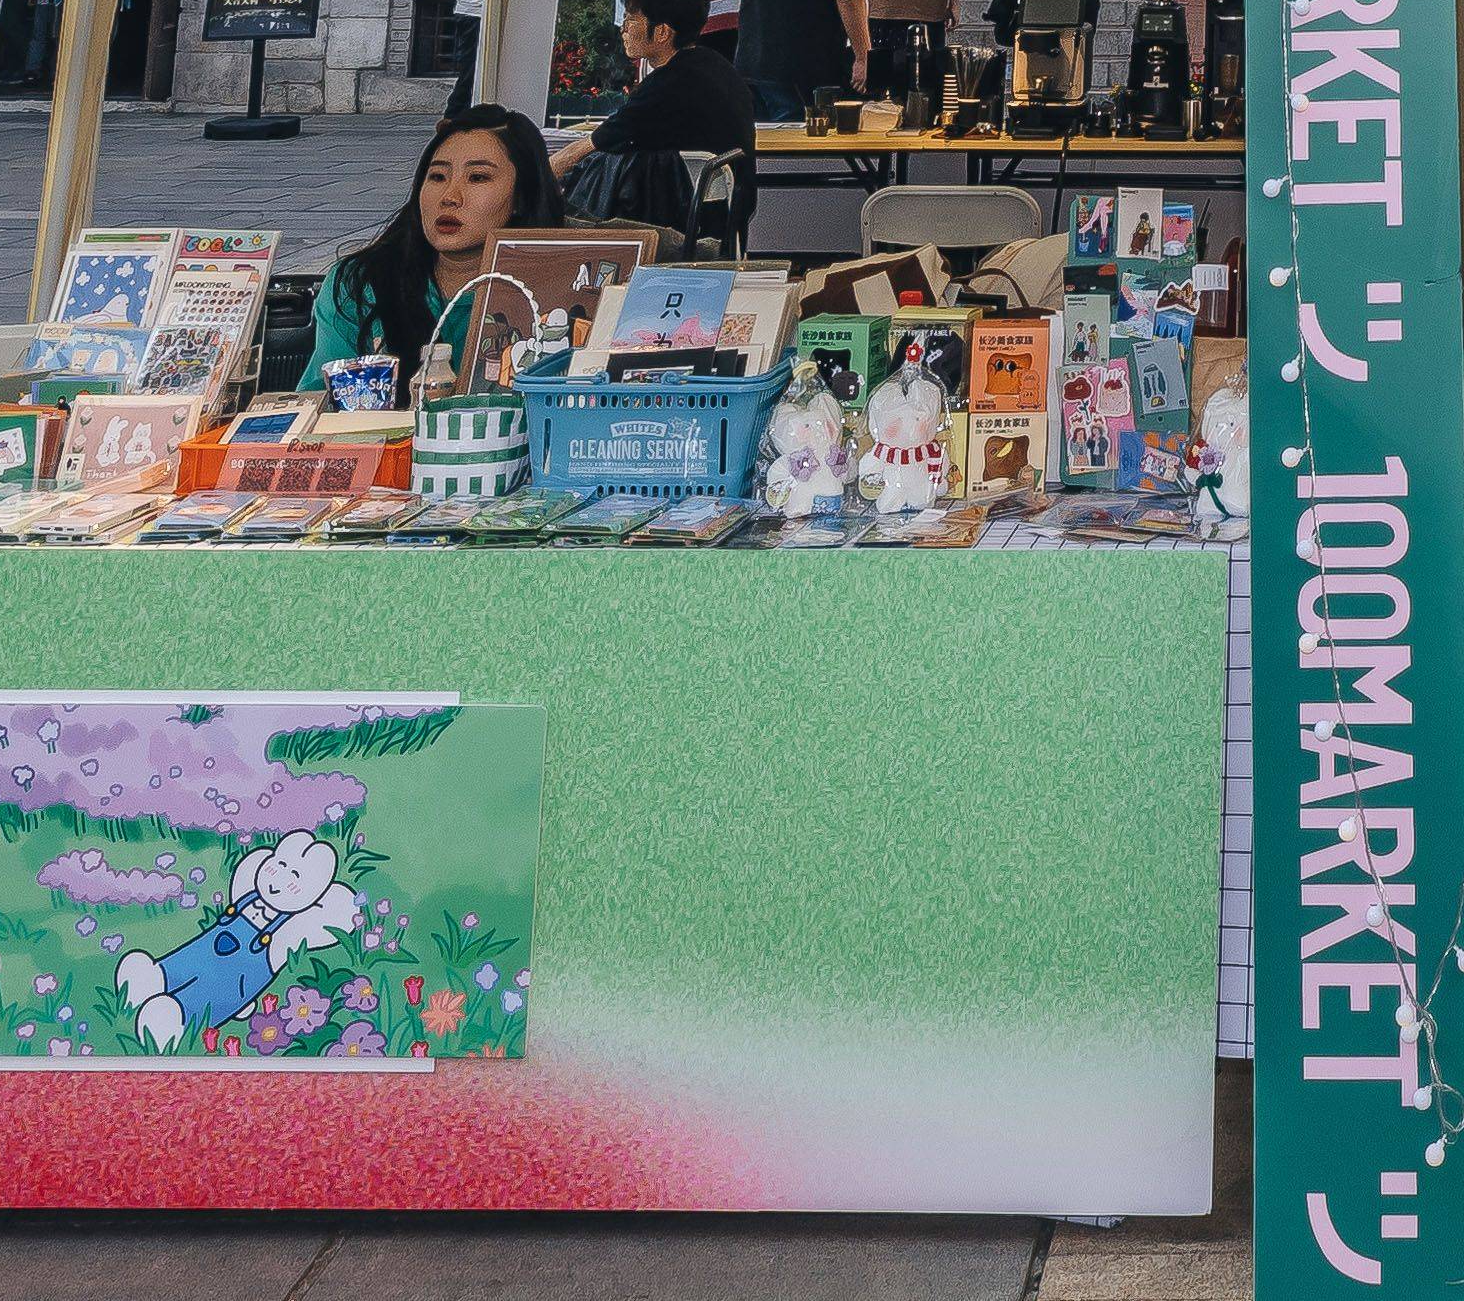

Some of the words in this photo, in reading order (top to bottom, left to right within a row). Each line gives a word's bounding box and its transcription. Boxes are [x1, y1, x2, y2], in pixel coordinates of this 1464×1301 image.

[568, 439, 641, 461] CLEANING
[645, 439, 708, 461] SERVICE
[1294, 455, 1417, 1107] 100MARKET
